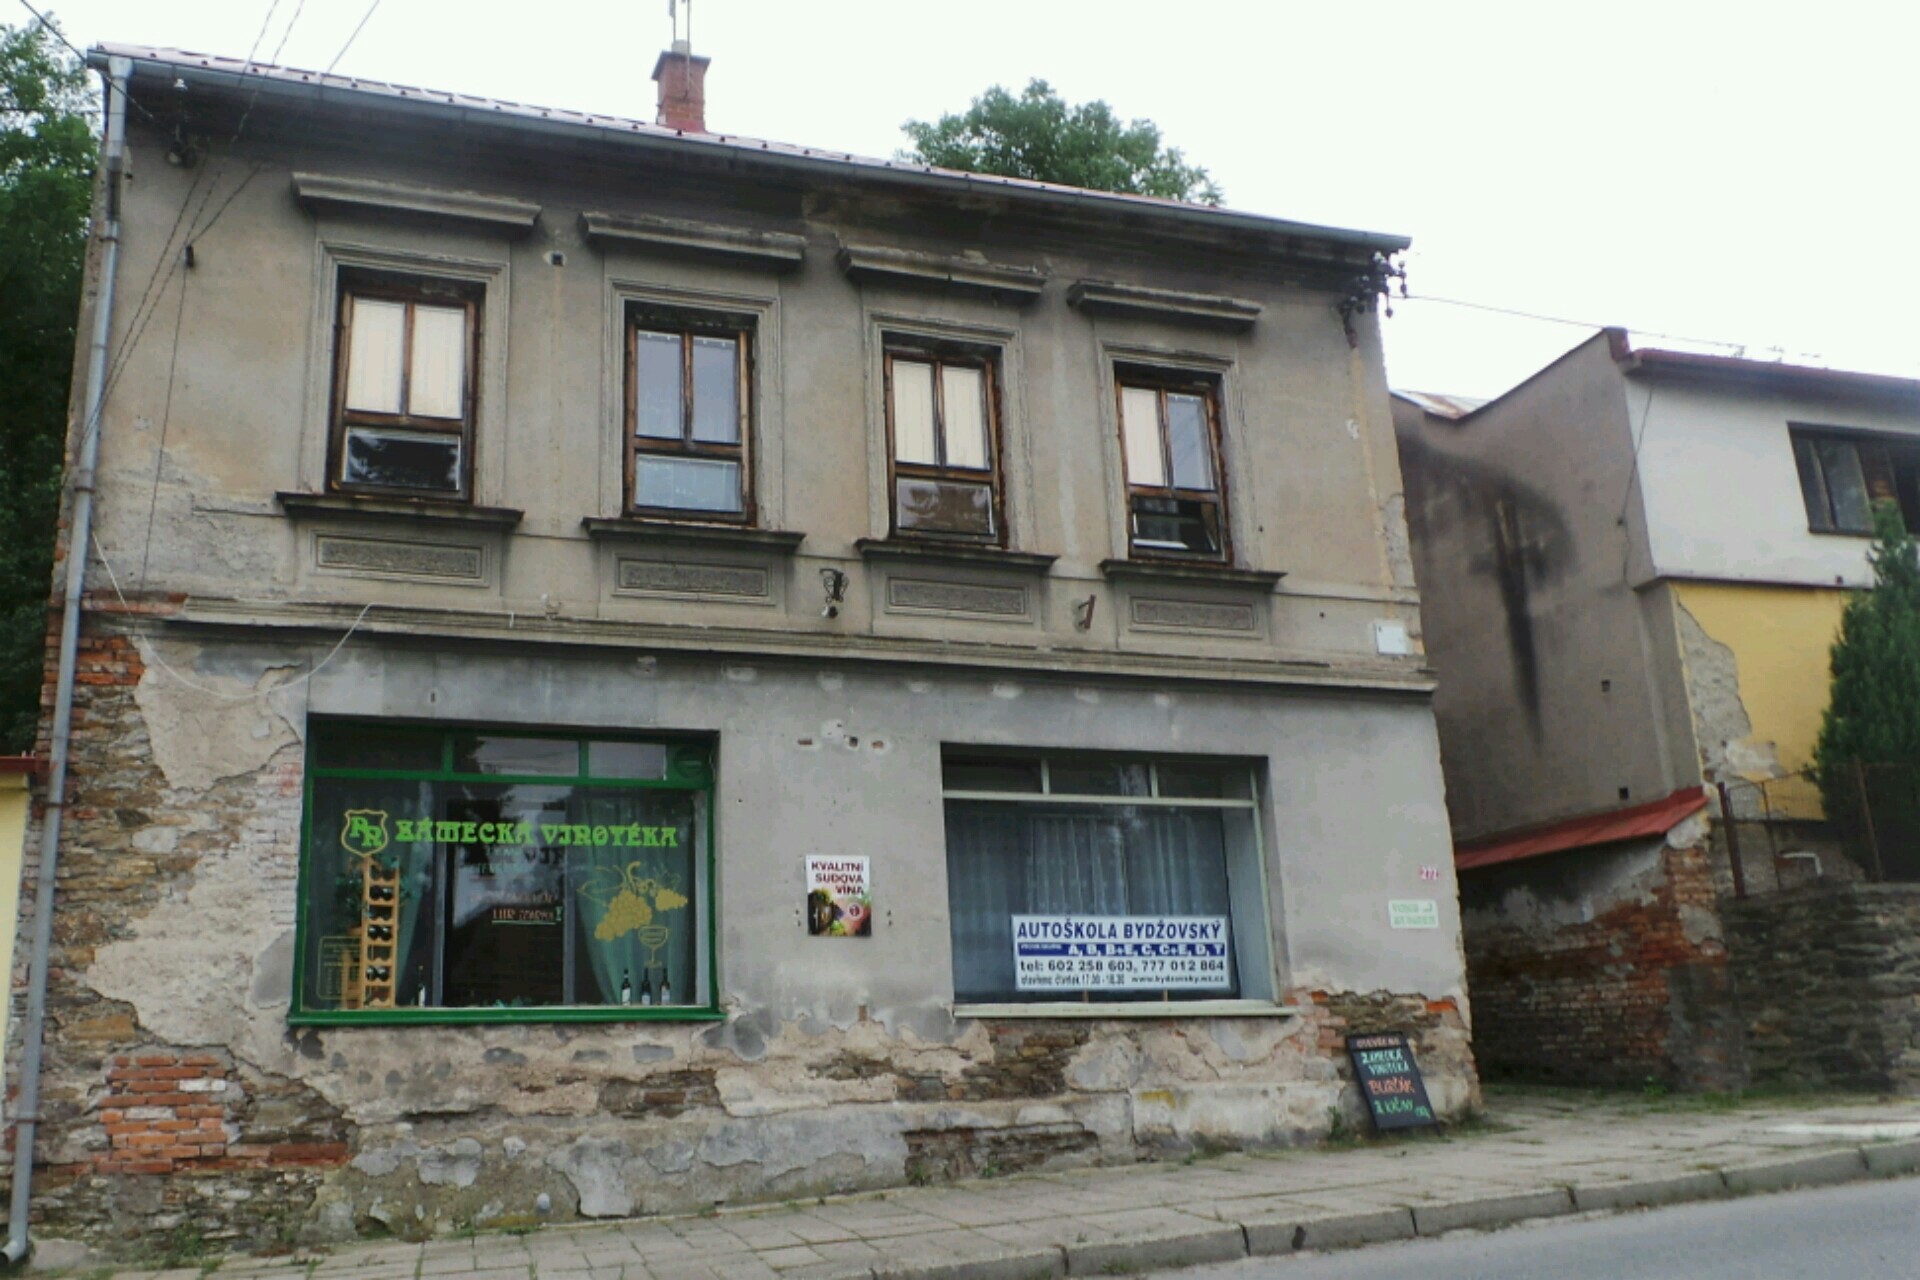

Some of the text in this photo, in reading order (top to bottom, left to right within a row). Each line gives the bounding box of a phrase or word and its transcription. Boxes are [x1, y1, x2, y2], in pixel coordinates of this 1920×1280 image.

[1017, 919, 1222, 939] AUTOŠKOLA BYDŽOVSKÝ
[1048, 960, 1073, 971] 602
[1142, 960, 1165, 972] 777
[1170, 960, 1196, 971] 012
